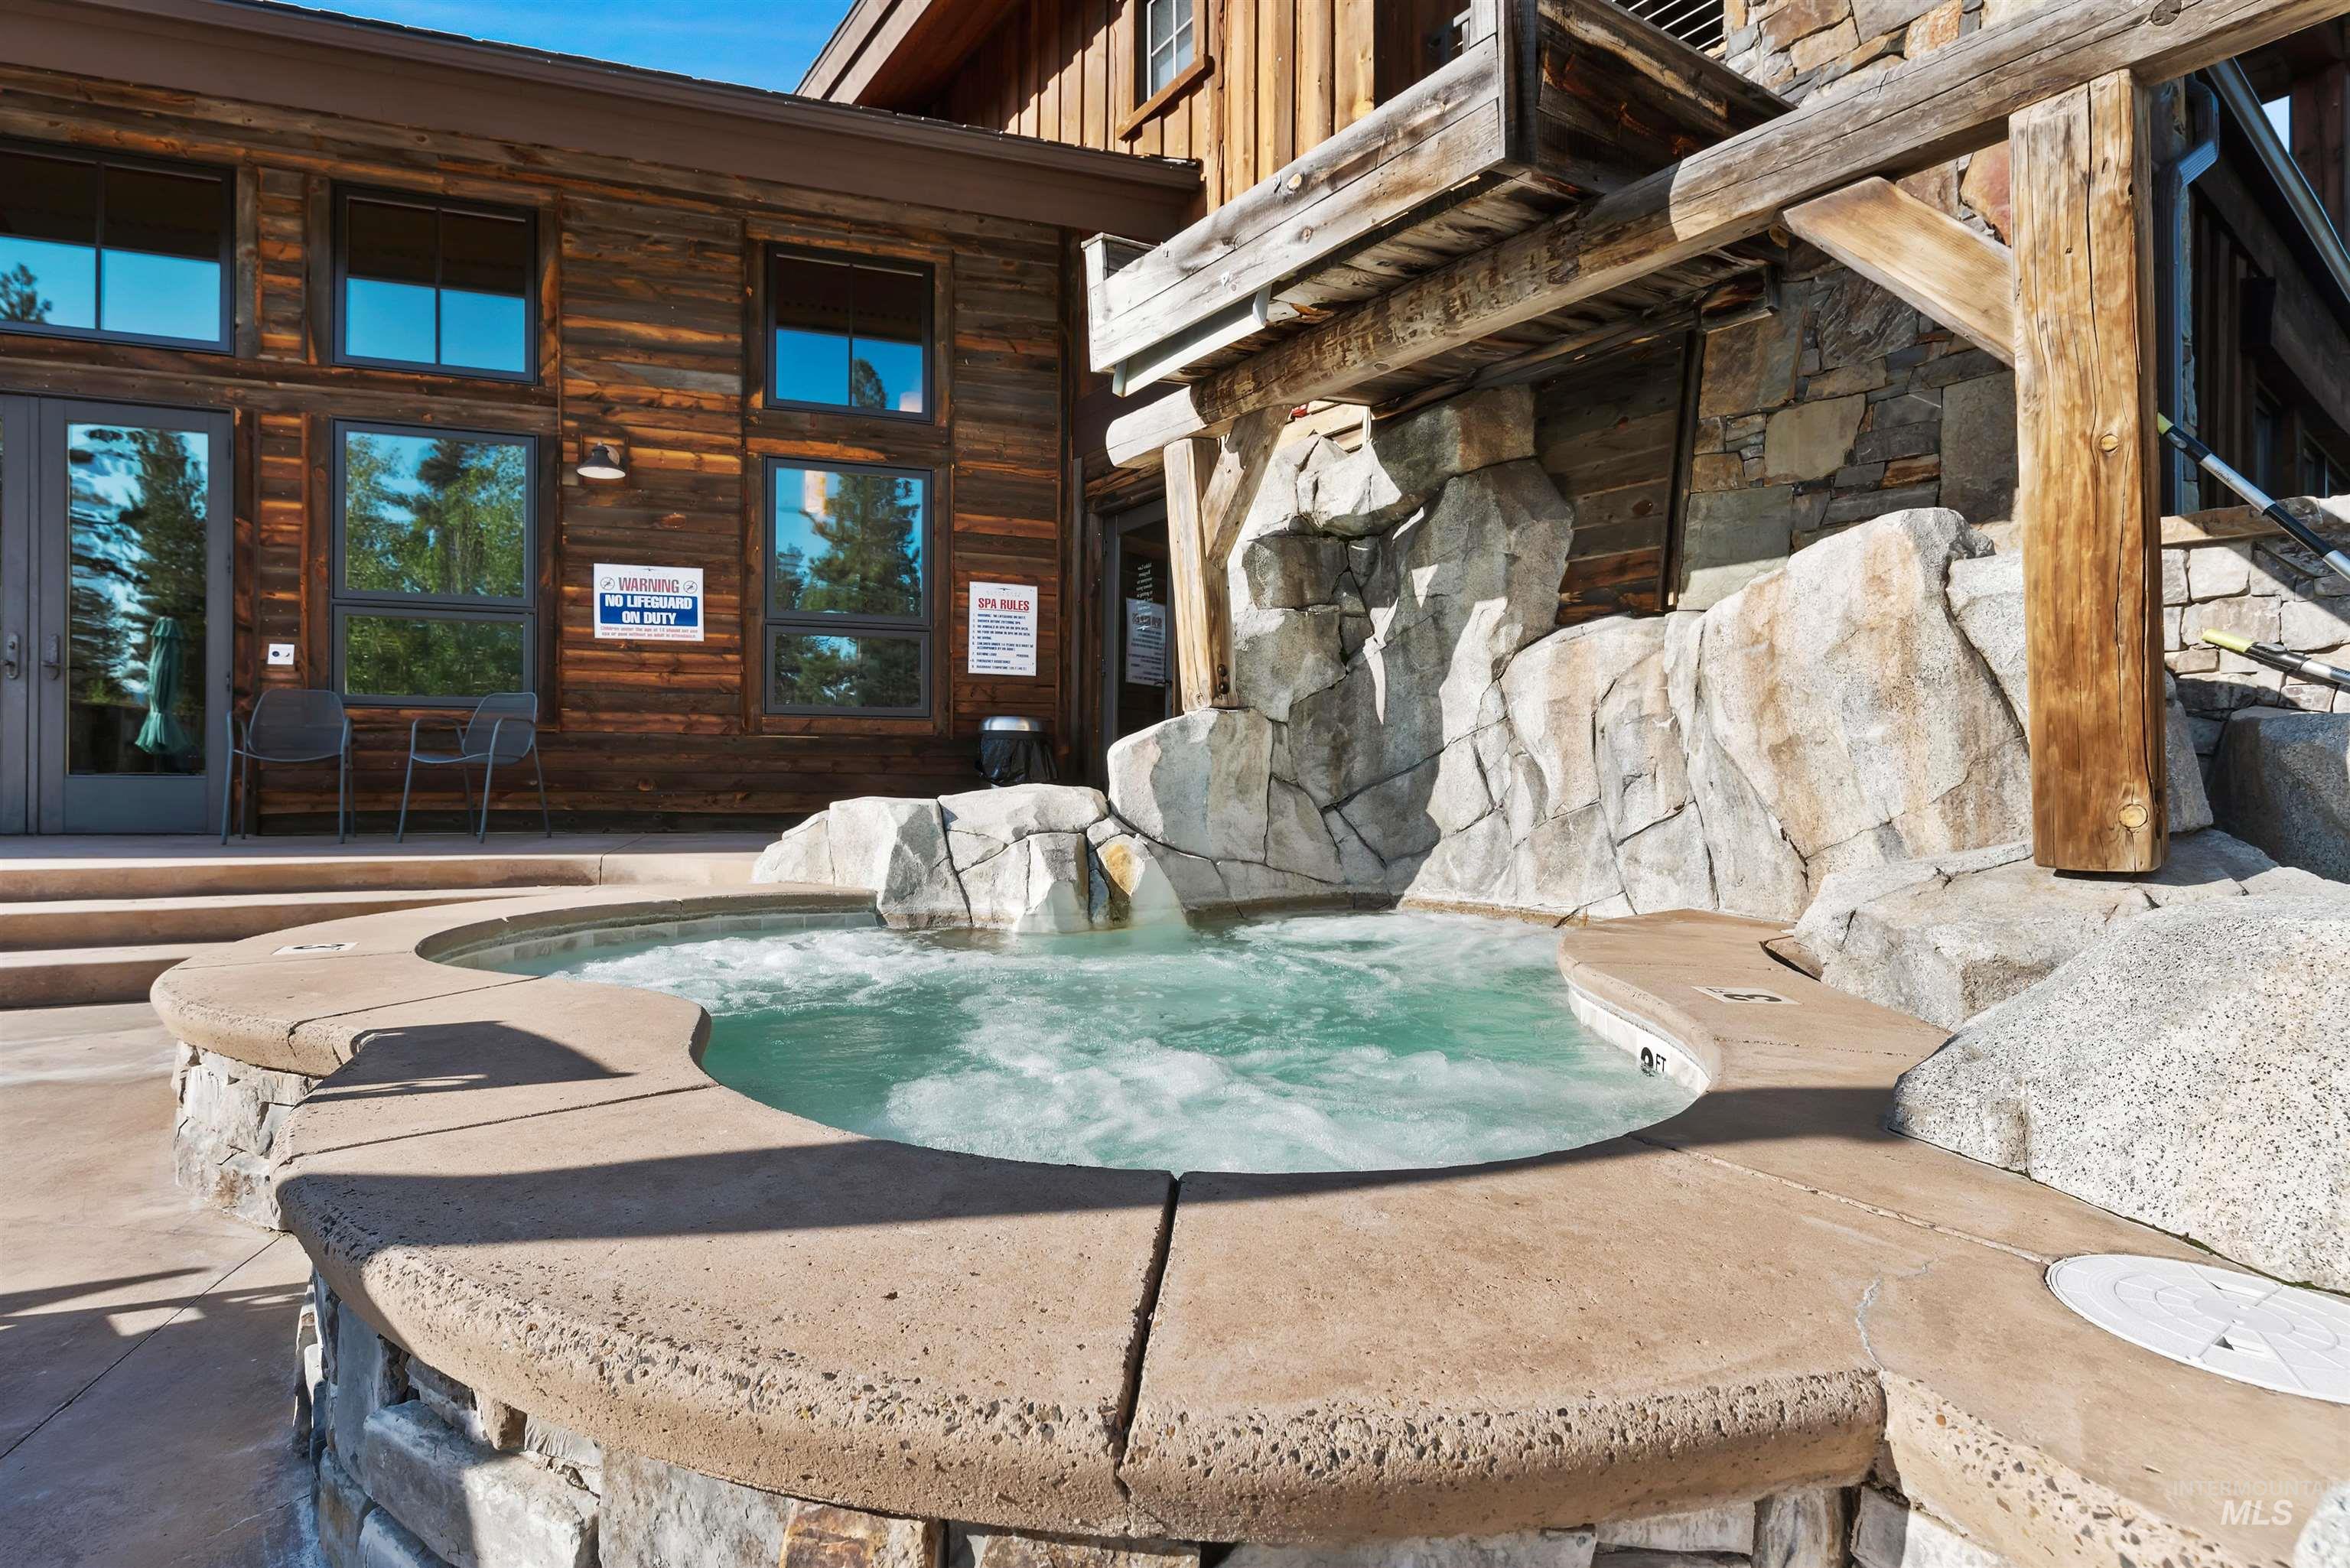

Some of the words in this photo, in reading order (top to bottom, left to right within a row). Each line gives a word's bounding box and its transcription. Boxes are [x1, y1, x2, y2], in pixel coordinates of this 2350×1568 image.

[618, 577, 679, 593] WARNING
[604, 594, 623, 607] NO
[627, 595, 693, 610] LIFEGUARD
[978, 597, 997, 609] SPA
[1000, 599, 1030, 611] RULES
[621, 610, 640, 623] ON
[643, 612, 677, 625] DUTY
[1655, 1052, 1667, 1073] FT
